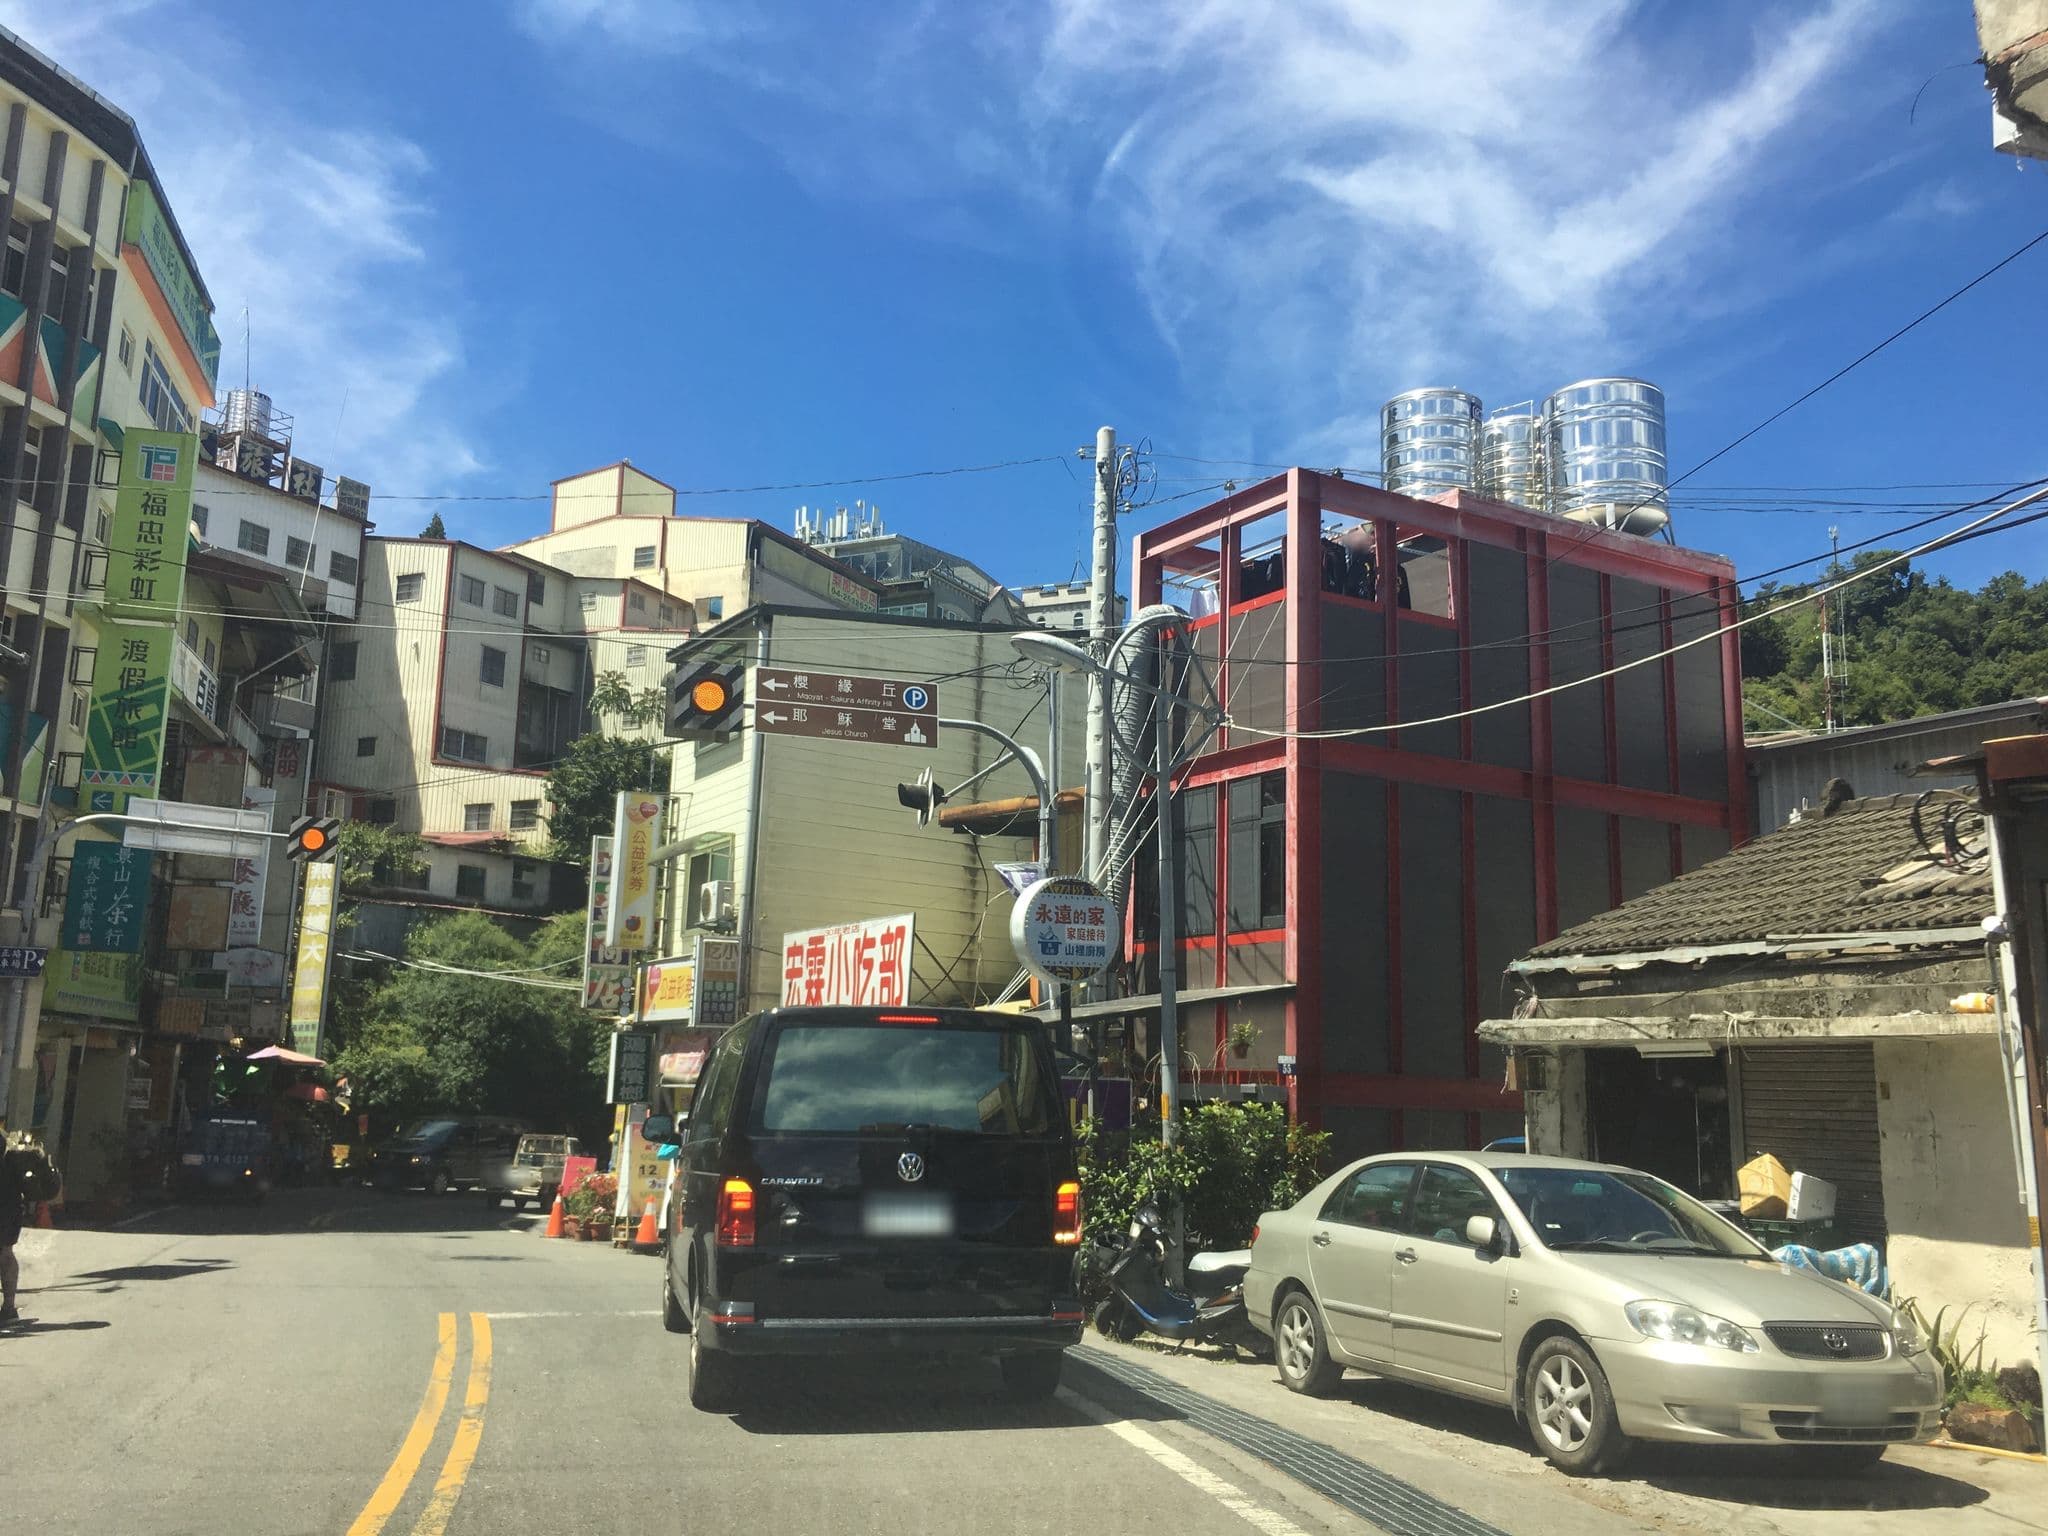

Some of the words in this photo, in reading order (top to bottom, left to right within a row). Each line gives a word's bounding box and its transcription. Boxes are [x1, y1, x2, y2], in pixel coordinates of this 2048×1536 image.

[129, 491, 168, 601] 福忠彩虹
[112, 639, 150, 749] 渡假旅館
[793, 675, 896, 697] 櫻緣丘
[831, 695, 854, 704] Sakura
[857, 697, 881, 707] Affinity
[792, 708, 897, 731] 耶穌堂
[822, 728, 843, 736] Jesus
[844, 729, 868, 738] Church
[629, 830, 647, 891] 公益彩券
[1035, 903, 1104, 925] 永遠的家
[1067, 927, 1105, 942] 家庭接待
[761, 1177, 823, 1187] CARAVELLE
